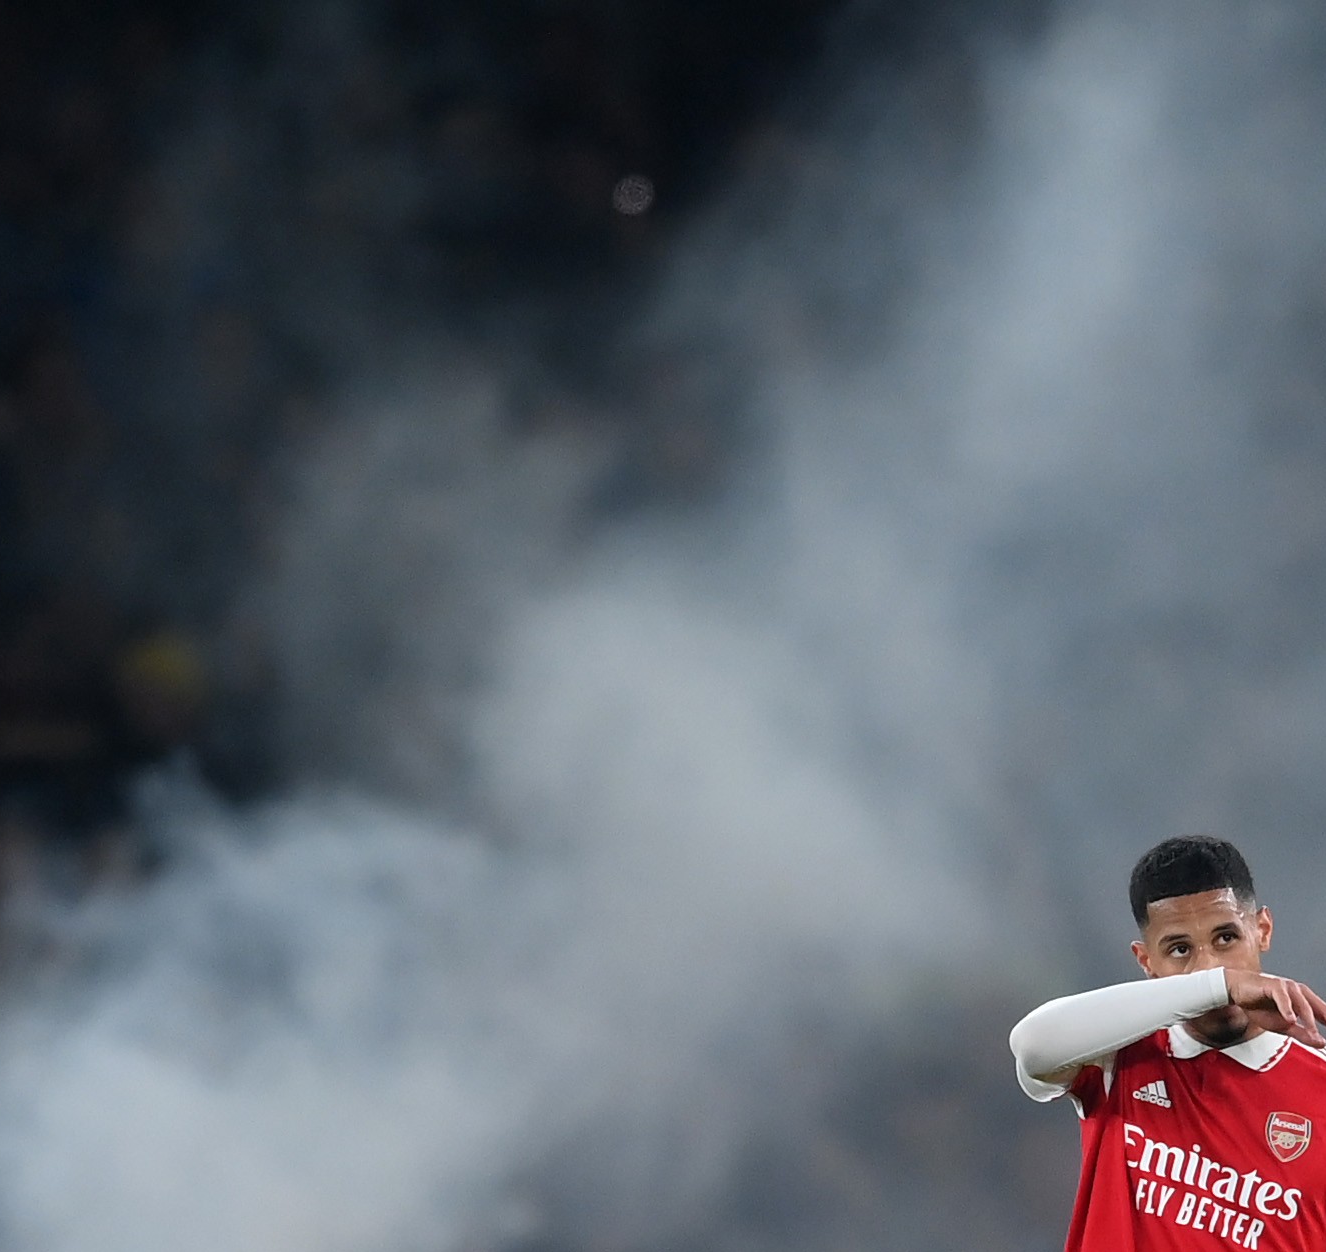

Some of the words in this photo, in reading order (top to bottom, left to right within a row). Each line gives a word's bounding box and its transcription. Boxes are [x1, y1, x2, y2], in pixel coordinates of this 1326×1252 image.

[1132, 1090, 1172, 1108] adidas
[1124, 1122, 1302, 1221] Emirates
[1136, 1178, 1175, 1217] FLY
[1175, 1192, 1265, 1251] BETTER
